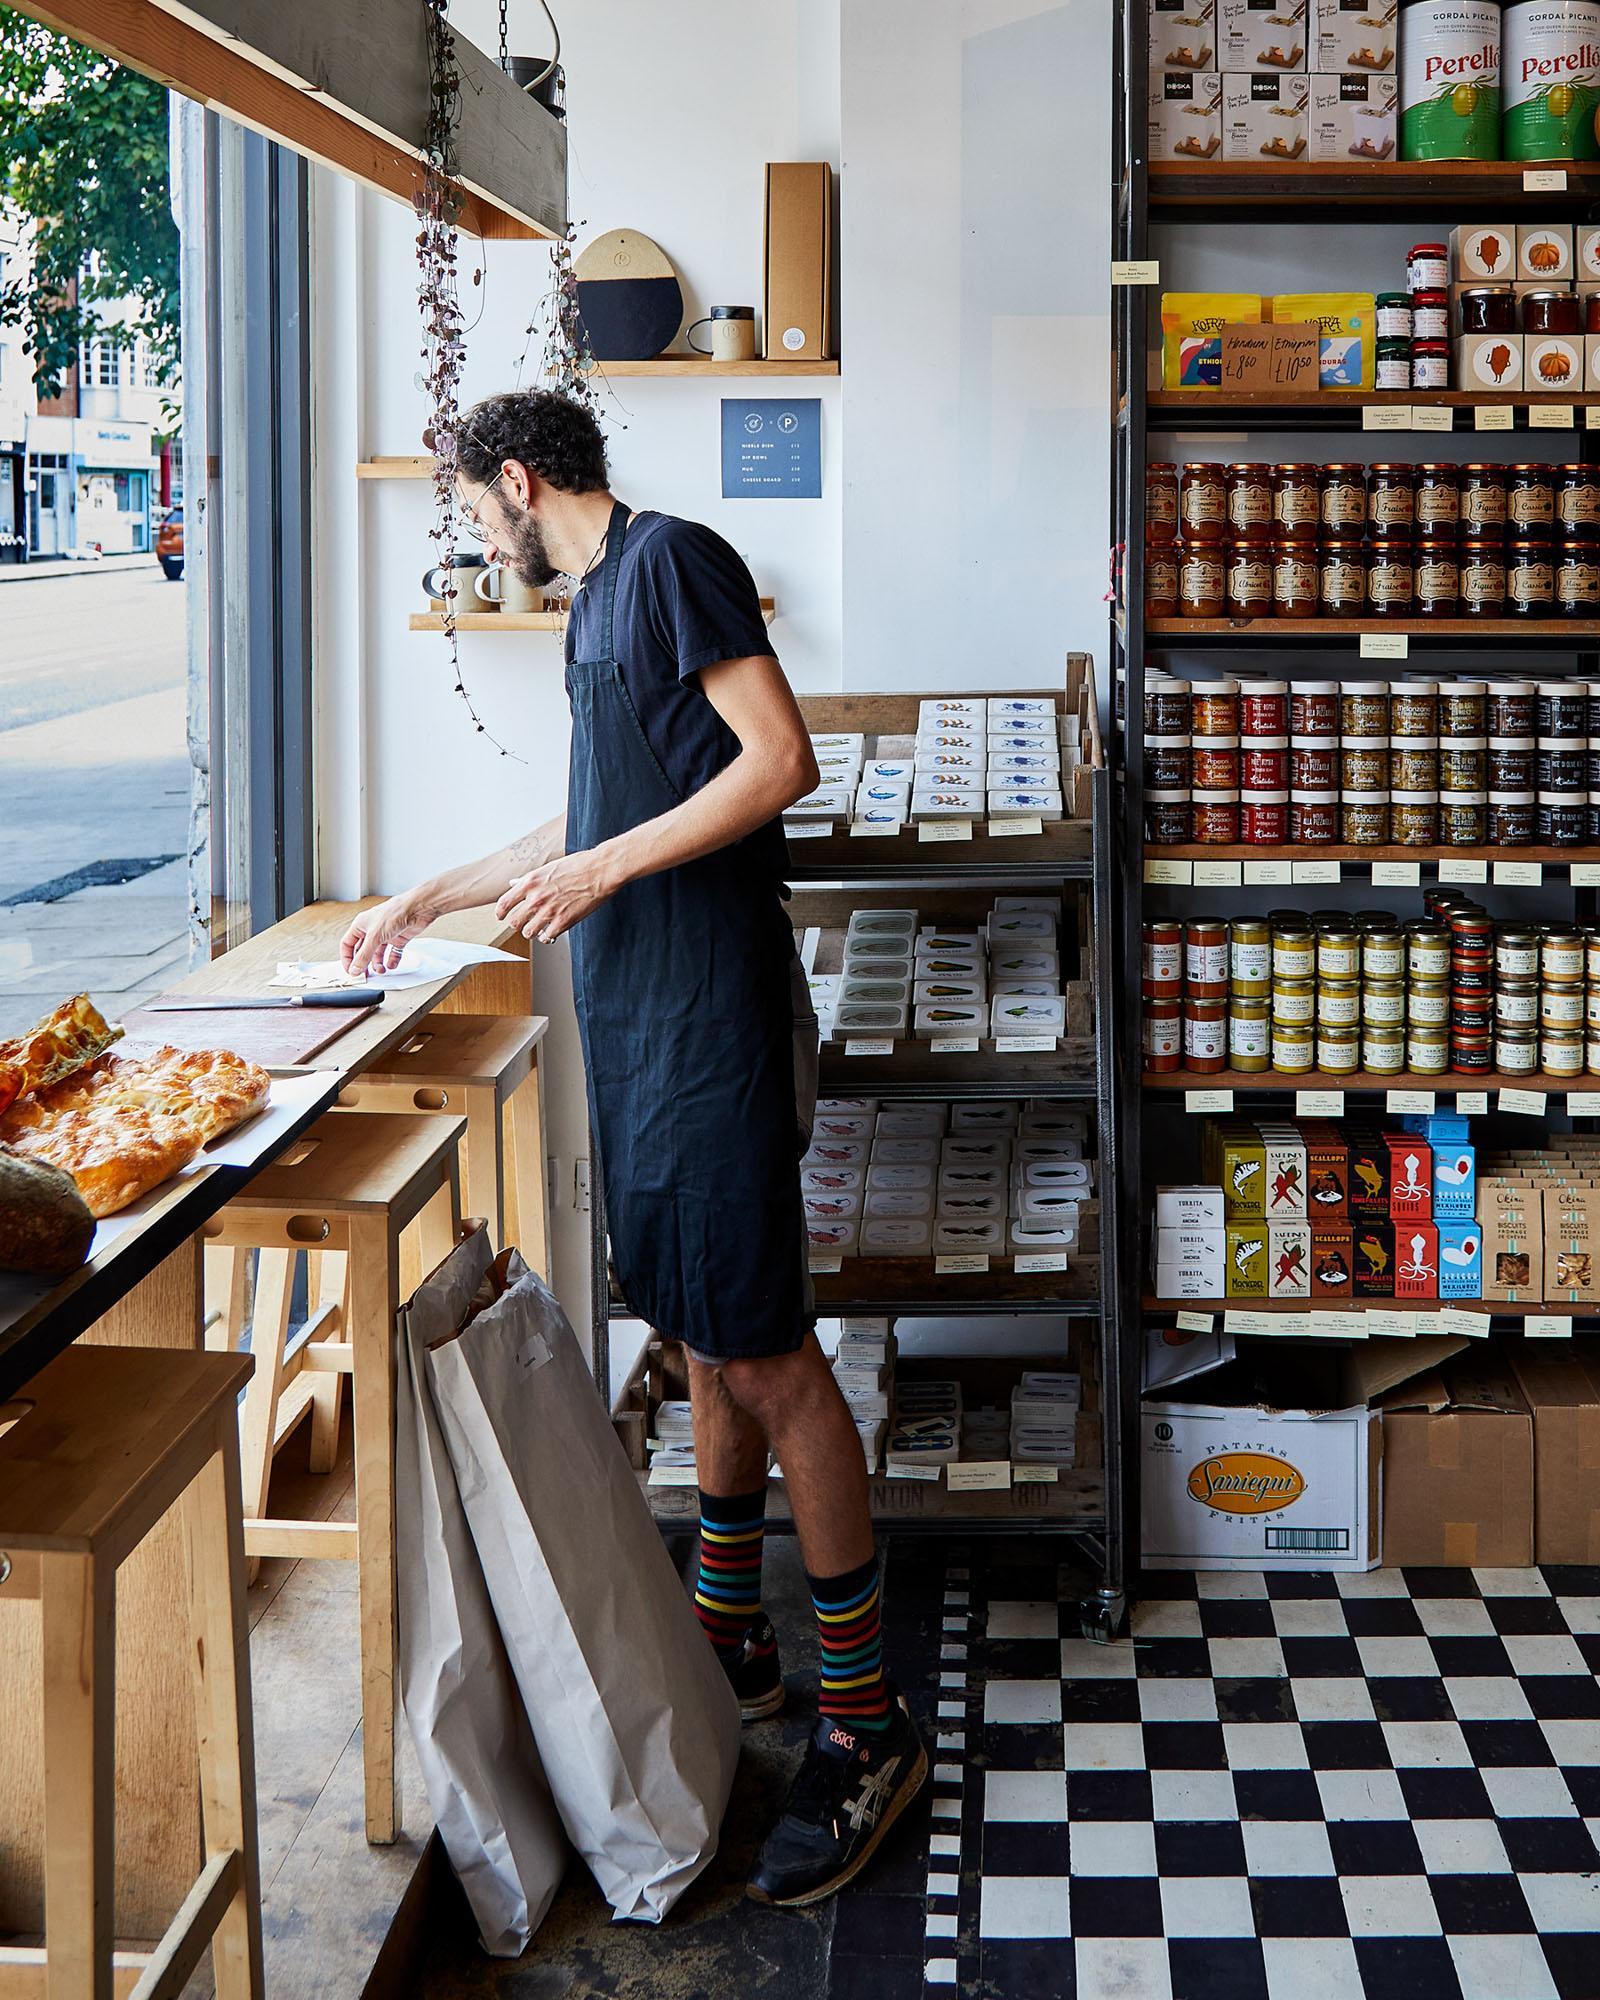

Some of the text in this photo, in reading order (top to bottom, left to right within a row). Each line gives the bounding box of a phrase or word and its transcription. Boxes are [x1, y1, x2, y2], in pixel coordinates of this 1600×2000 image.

[1472, 13, 1498, 24] PICANTE
[1528, 13, 1598, 24] GORDAL PICANTE
[1426, 44, 1500, 81] Perelló
[1522, 44, 1600, 82] Perelló
[1380, 502, 1406, 512] Fraise
[1522, 503, 1543, 511] Cassis
[1375, 582, 1400, 592] Fraise
[1522, 582, 1544, 590] Cassis
[1207, 704, 1229, 712] Peperoni
[1207, 758, 1229, 766] Peperoni
[1208, 812, 1229, 820] Peperoni
[1230, 1200, 1262, 1208] MACKEREL
[1392, 1202, 1420, 1212] SQUIDS
[1232, 1279, 1264, 1288] MACKEREL
[1398, 1282, 1425, 1292] SQUIDS
[1158, 1425, 1171, 1438] 10
[1206, 1442, 1288, 1454] PATATAS
[1187, 1460, 1309, 1502] Sarriegui
[1209, 1511, 1286, 1524] FRITAS
